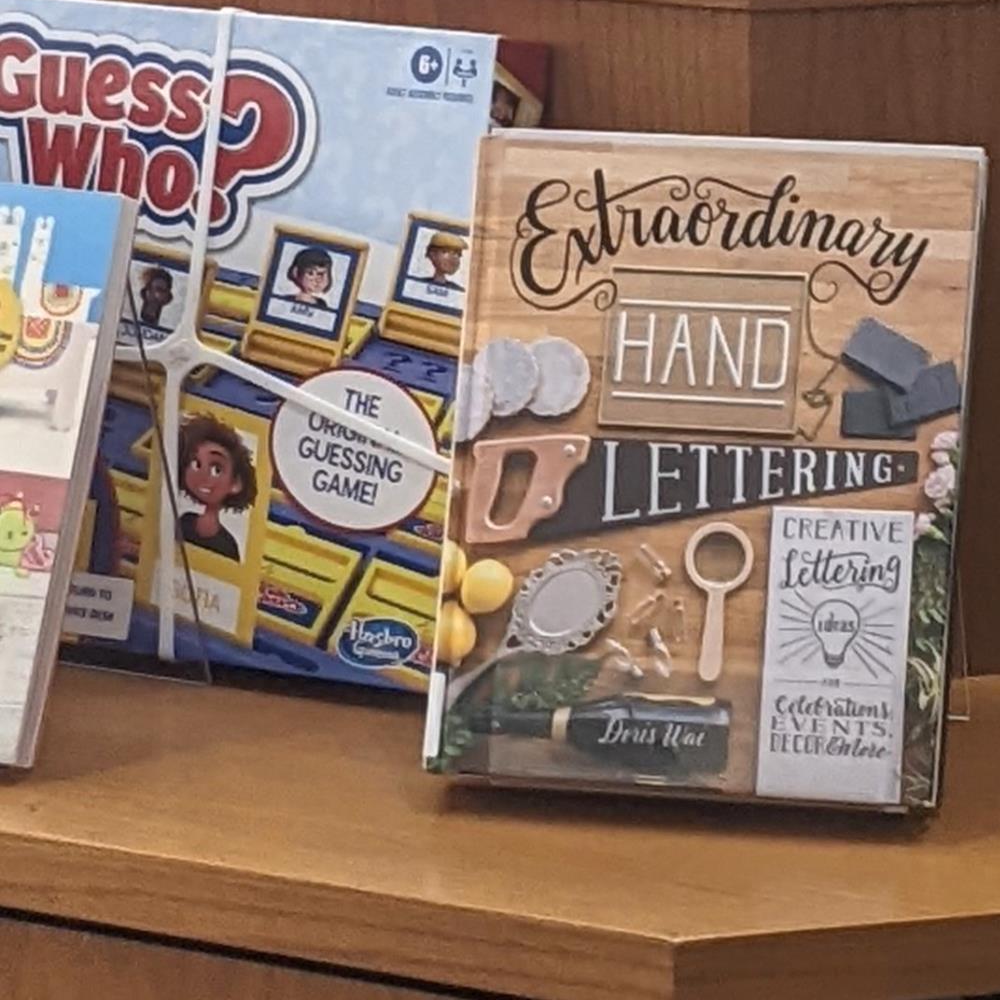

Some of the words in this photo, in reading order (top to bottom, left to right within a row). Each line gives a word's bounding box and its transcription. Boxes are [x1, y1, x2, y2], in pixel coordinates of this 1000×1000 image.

[510, 168, 931, 312] Extraordinary
[612, 311, 791, 391] HAND
[345, 388, 382, 419] THE
[298, 436, 404, 484] GUESSING
[601, 440, 893, 524] LETTERING
[312, 469, 379, 507] GAME!
[783, 516, 905, 544] CREATIVE
[779, 547, 902, 594] Lettering
[350, 620, 413, 649] Hasbro
